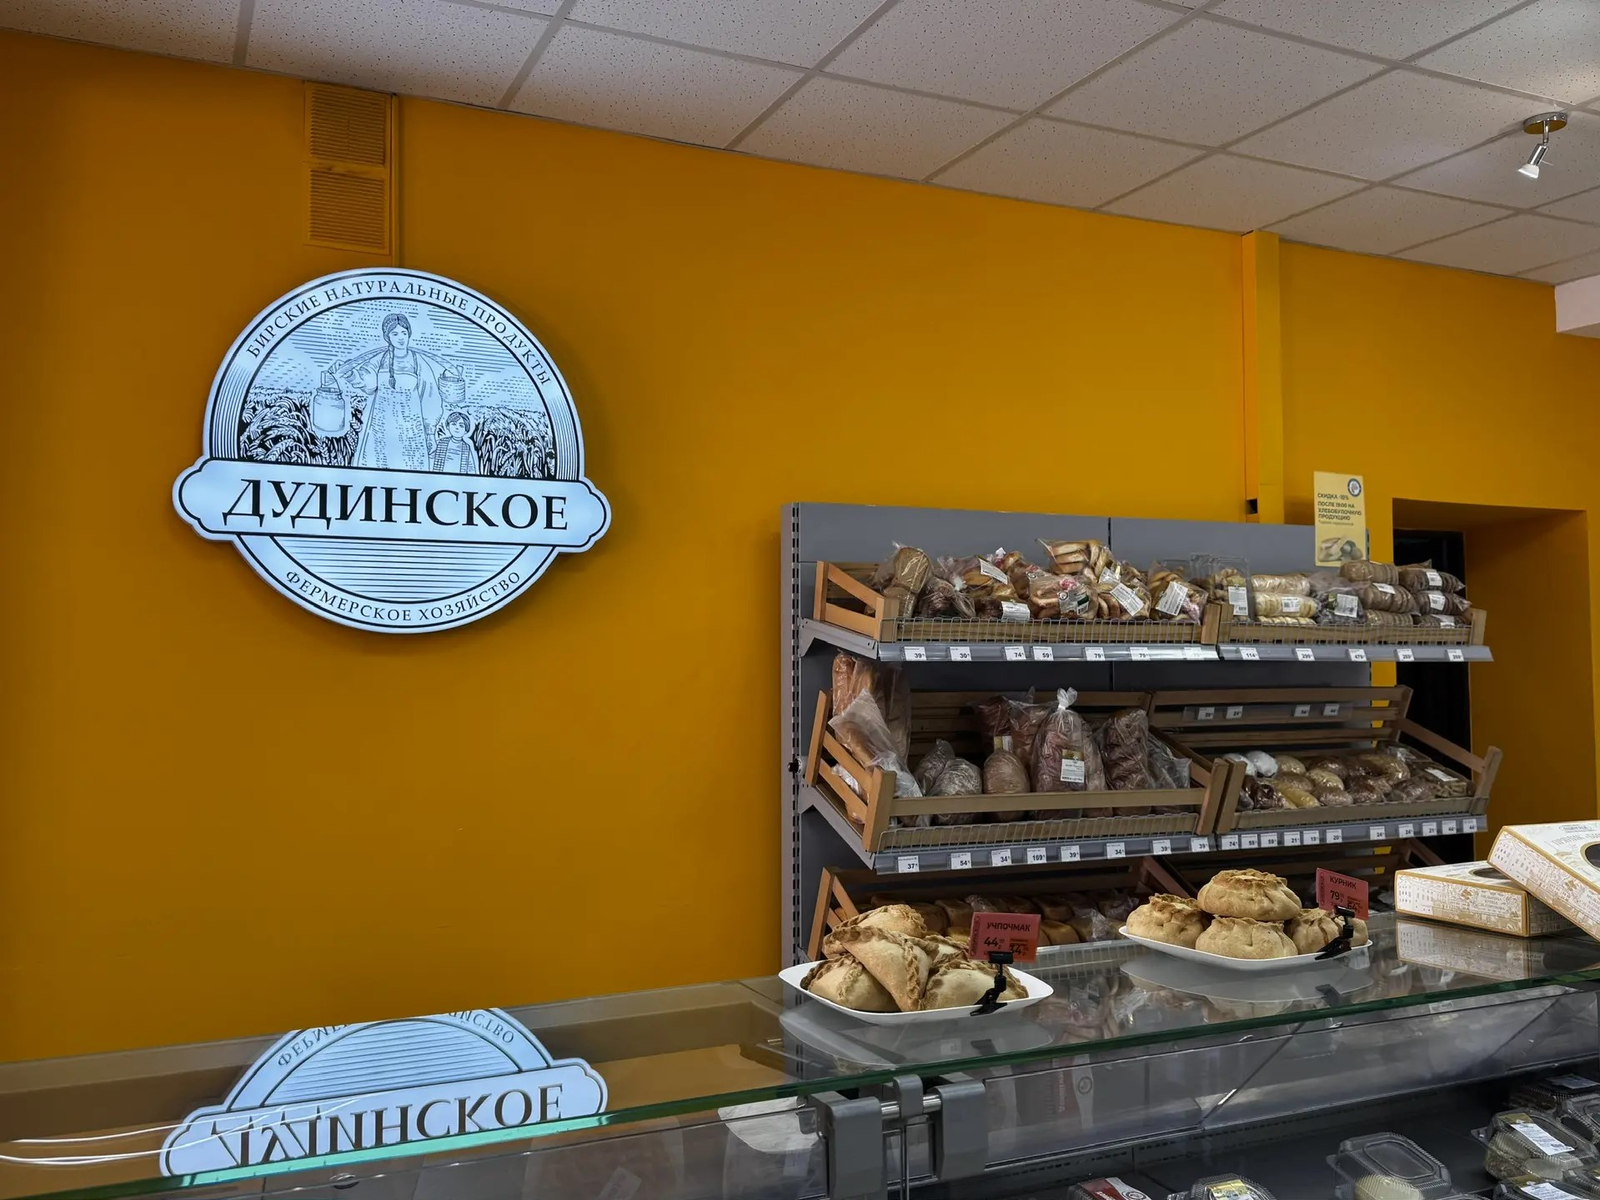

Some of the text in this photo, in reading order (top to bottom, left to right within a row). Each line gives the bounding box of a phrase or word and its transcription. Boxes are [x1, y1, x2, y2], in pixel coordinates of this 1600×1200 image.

[245, 278, 554, 386] БИРСКИЕ НАТУРАЛЬНЫЕ ПРОДУКТЫ
[222, 477, 570, 531] ДУДИНСКОЕ
[284, 569, 522, 622] ФЕРМЕРСКОЕ ХОЗЯЙСТВО
[1329, 875, 1357, 890] КУРНИК
[986, 922, 1031, 932] УЧПОЧМАК
